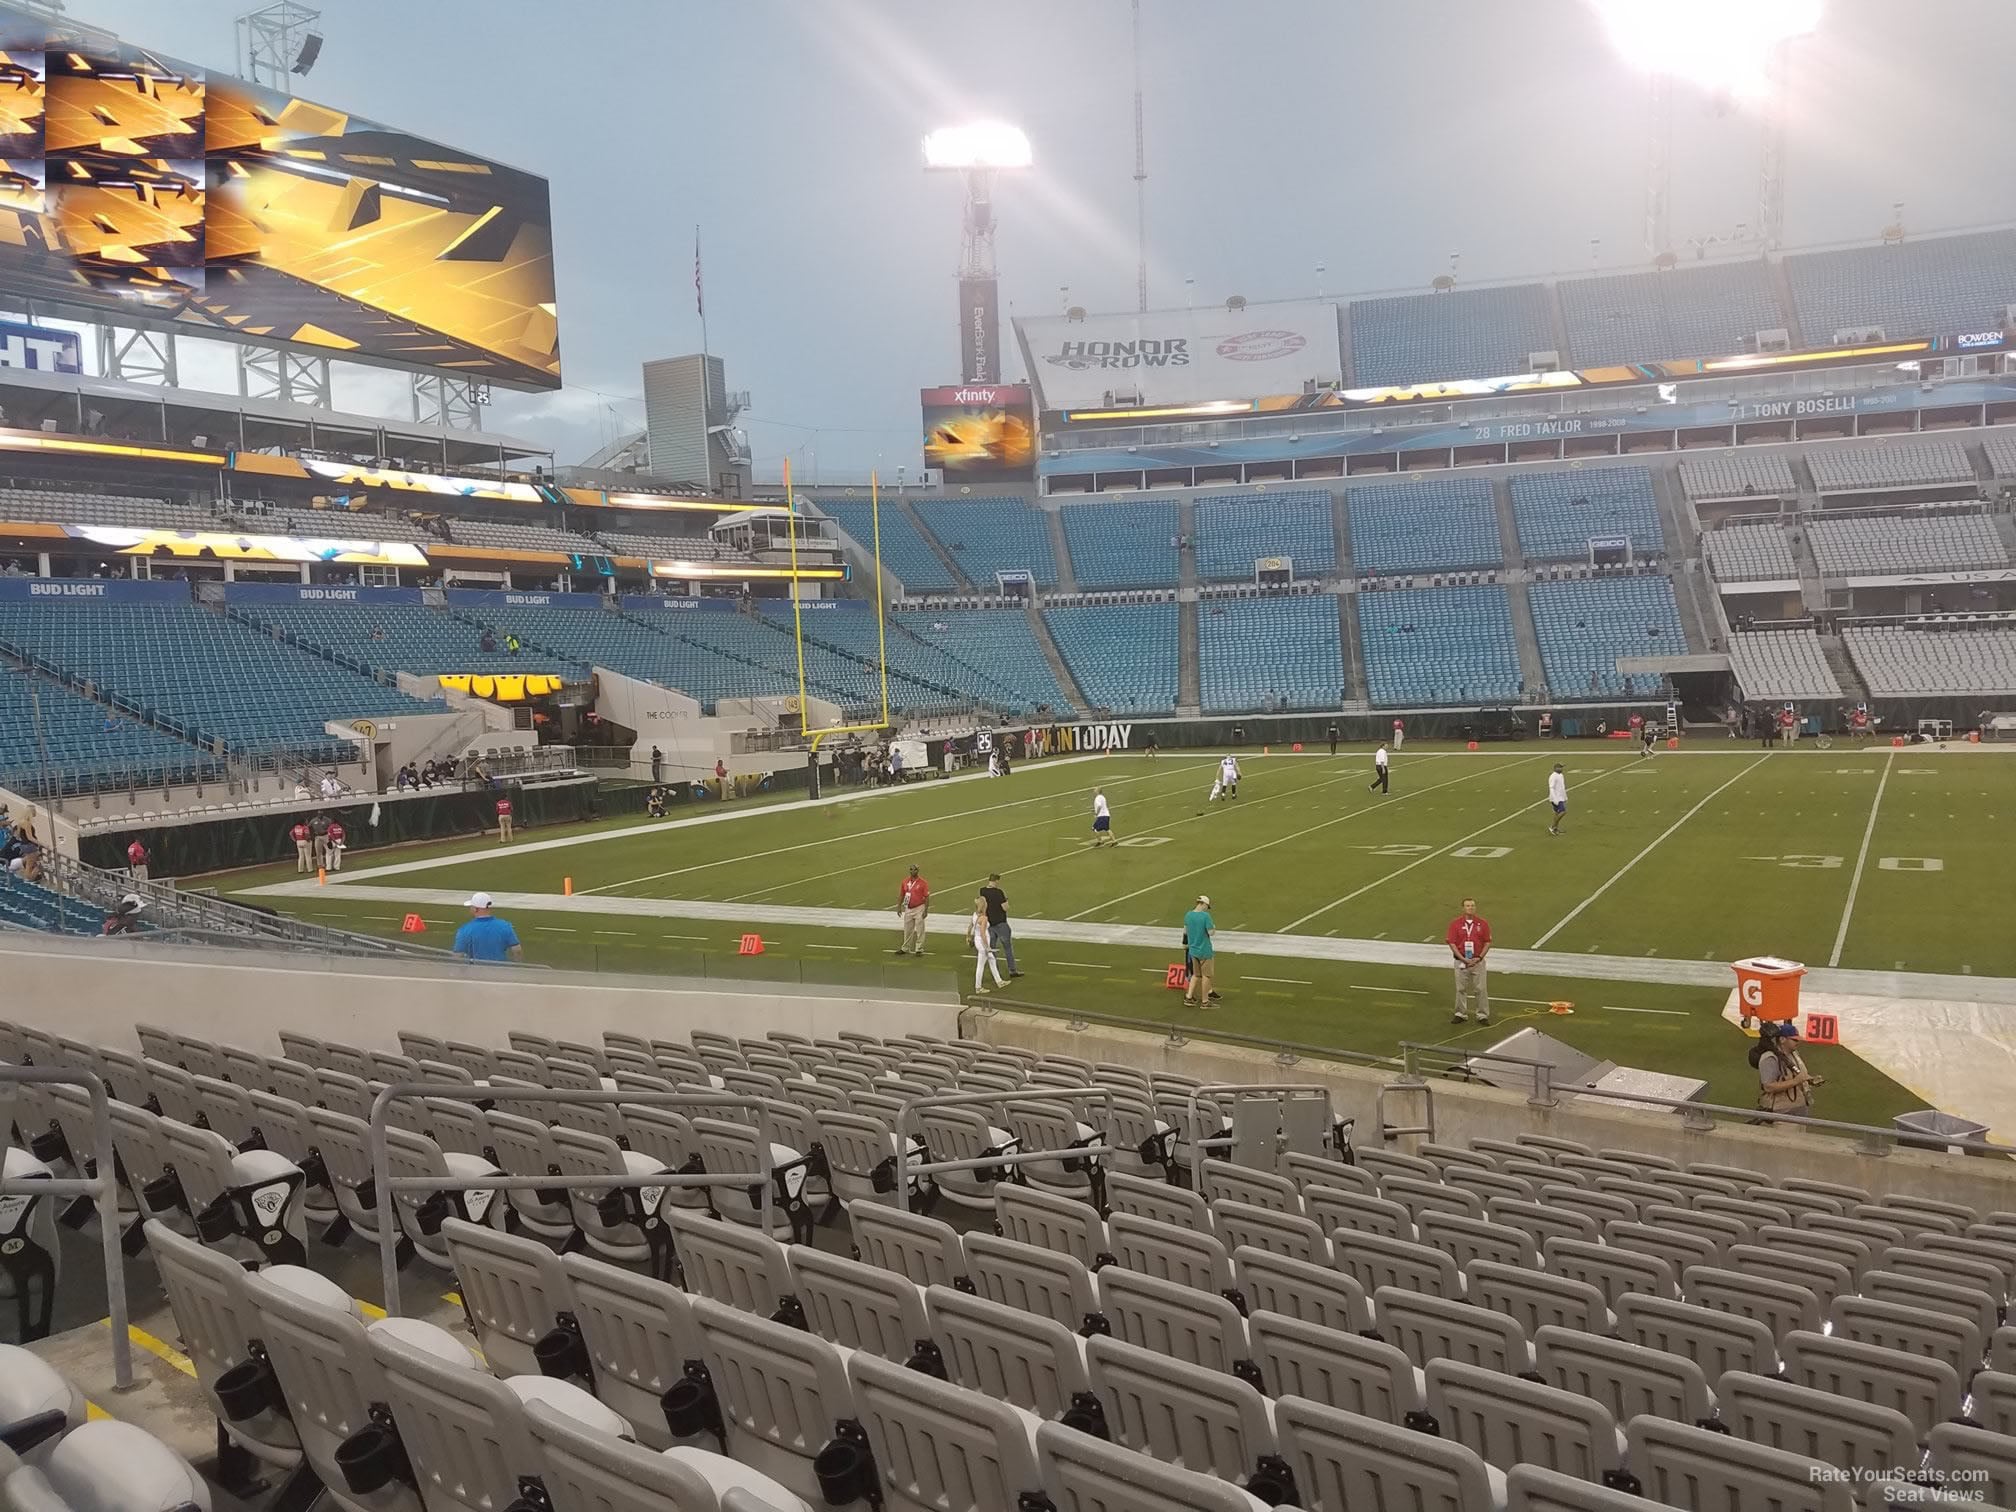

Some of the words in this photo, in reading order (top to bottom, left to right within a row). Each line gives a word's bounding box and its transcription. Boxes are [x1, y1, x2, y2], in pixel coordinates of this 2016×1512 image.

[1959, 331, 2003, 343] BOWDEN
[1062, 339, 1188, 356] HONOR
[1100, 354, 1190, 368] ROWS
[478, 392, 488, 403] 25
[955, 388, 995, 403] xfinity
[1753, 402, 1791, 417] TONY
[1796, 397, 1856, 410] BOSELLI
[1475, 428, 1490, 439] 28
[1501, 424, 1530, 438] FRED
[1535, 420, 1582, 434] TAYLOR
[1592, 539, 1625, 548] GEICO
[30, 583, 62, 595] BUD
[63, 584, 105, 596] LIGHT
[300, 589, 324, 599] BUD
[325, 590, 357, 600] LIGHT
[506, 595, 524, 604] BUD
[525, 595, 550, 604] LIGHT
[664, 600, 679, 608] BUD
[679, 600, 699, 608] LIGHT
[646, 711, 658, 720] THE
[979, 733, 991, 749] 25
[743, 936, 755, 951] 10
[1168, 967, 1186, 986] 20
[1742, 979, 1763, 1006] G
[1808, 1016, 1835, 1039] 30
